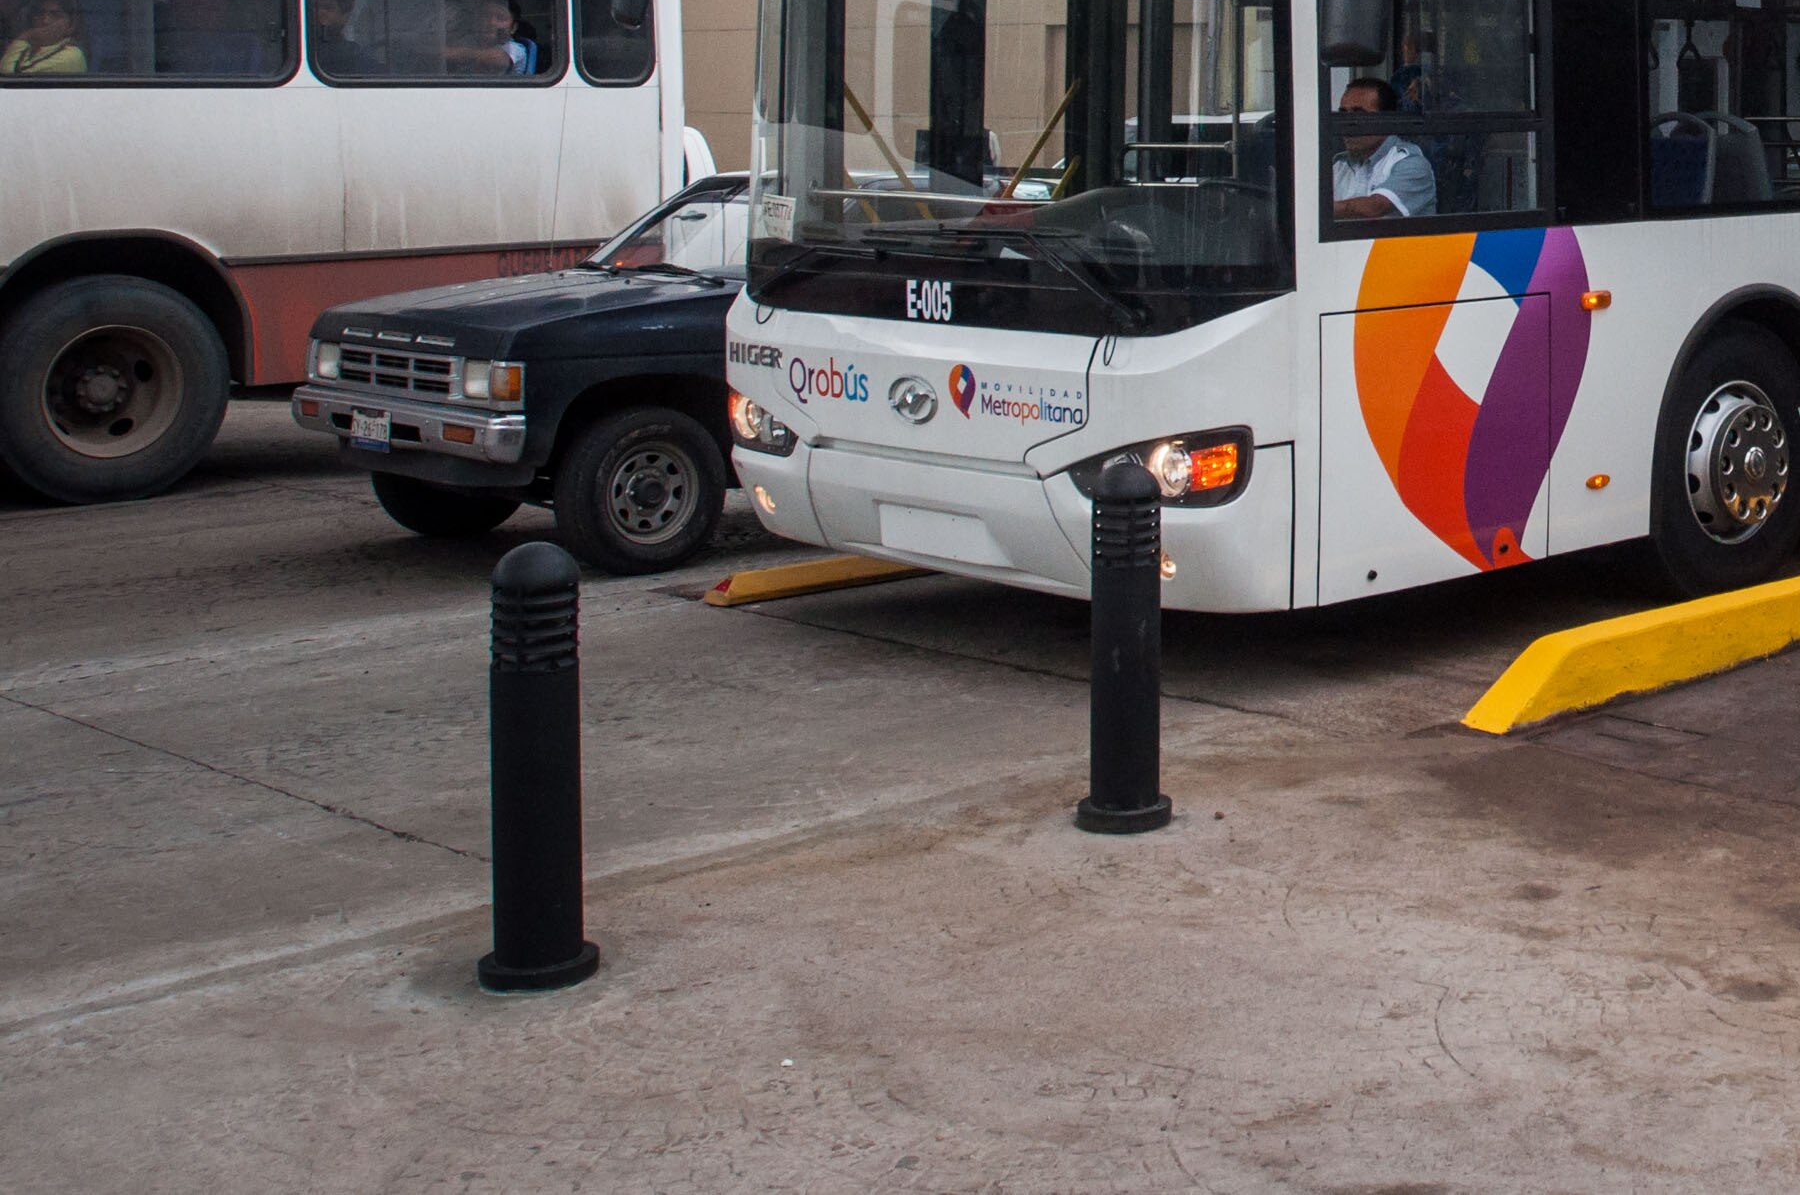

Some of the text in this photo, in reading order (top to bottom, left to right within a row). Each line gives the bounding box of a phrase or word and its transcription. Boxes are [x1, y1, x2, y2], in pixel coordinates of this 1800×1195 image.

[906, 280, 953, 323] E-005
[729, 341, 783, 370] HIGER
[789, 356, 869, 404] Qrobús
[981, 382, 1082, 399] MOVILIDAD
[981, 393, 1083, 427] Metropolitana
